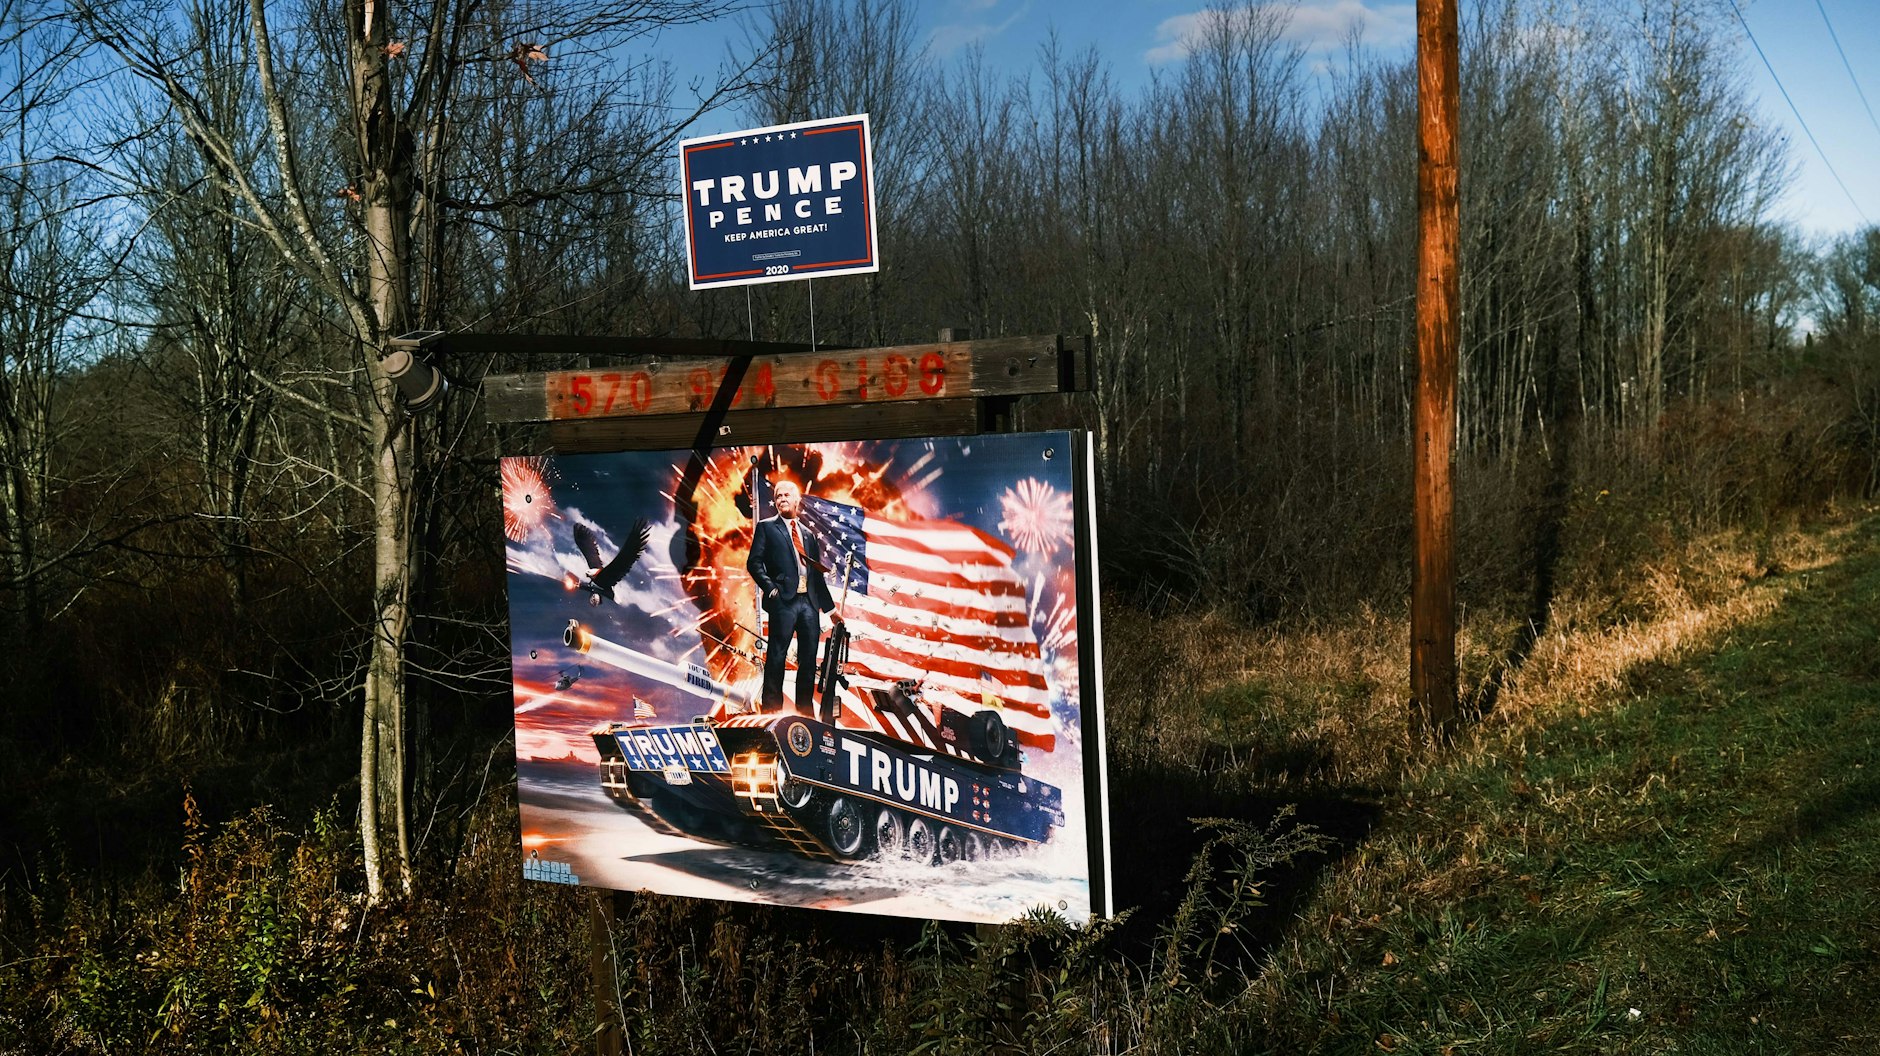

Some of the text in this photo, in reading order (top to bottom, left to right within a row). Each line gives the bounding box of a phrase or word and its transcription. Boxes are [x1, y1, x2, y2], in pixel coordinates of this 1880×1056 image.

[693, 161, 857, 206] TRUMP
[709, 196, 842, 228] PENCE
[724, 223, 828, 242] KEEP AMERICA GREAT!
[765, 264, 789, 275] 2020
[571, 371, 652, 415] 570
[617, 731, 717, 755] TRUMP
[841, 737, 959, 813] TRUMP
[523, 858, 571, 874] JASON
[523, 870, 579, 885] HEUSER
